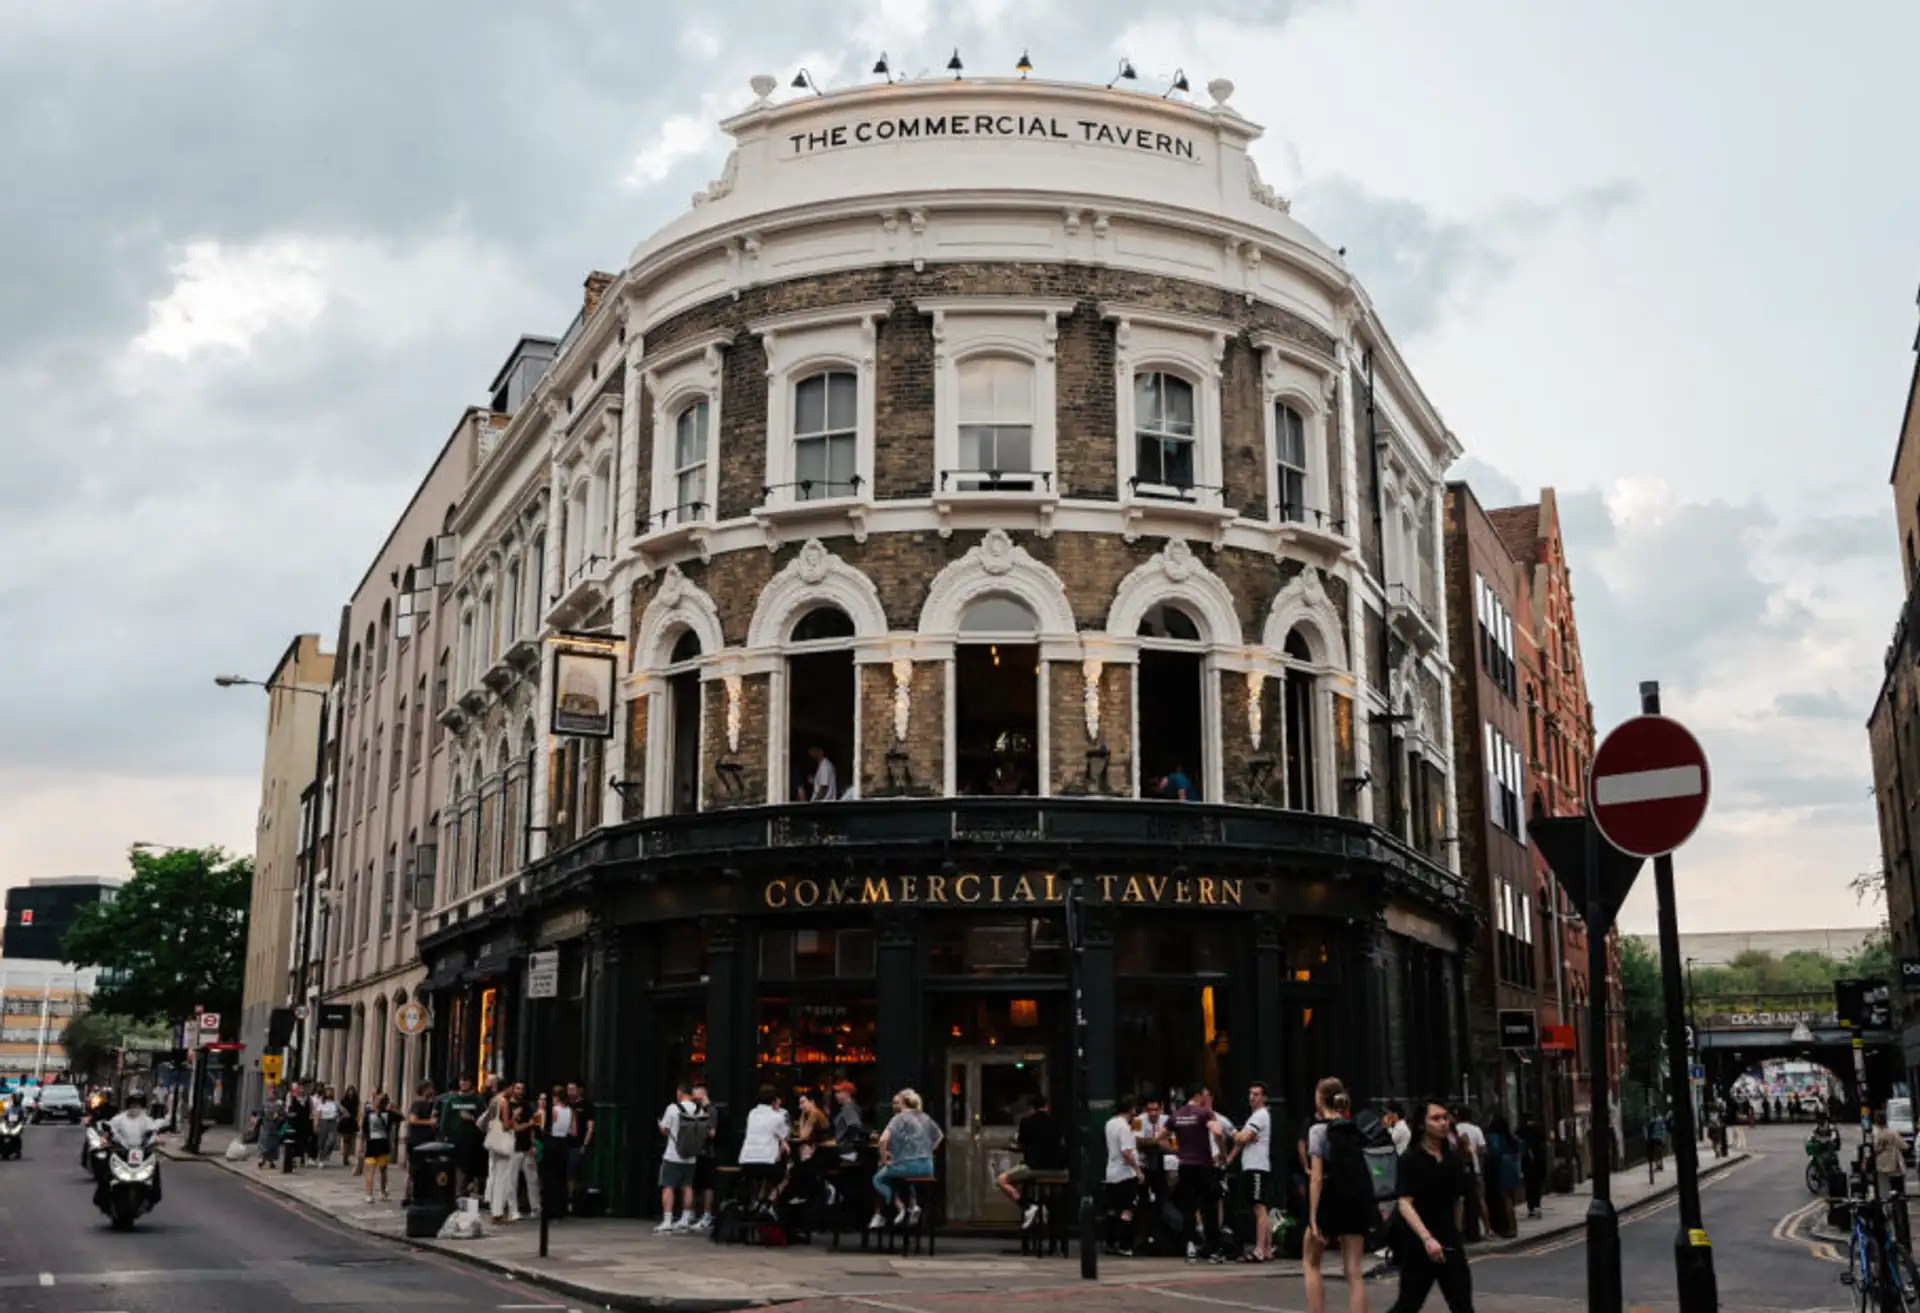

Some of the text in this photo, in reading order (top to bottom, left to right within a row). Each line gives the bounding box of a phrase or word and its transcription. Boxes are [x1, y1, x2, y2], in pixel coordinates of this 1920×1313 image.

[790, 126, 847, 153] THE
[855, 116, 1068, 141] COMMERCIAL
[765, 874, 1244, 908] COMMERCIAL TAVERN
